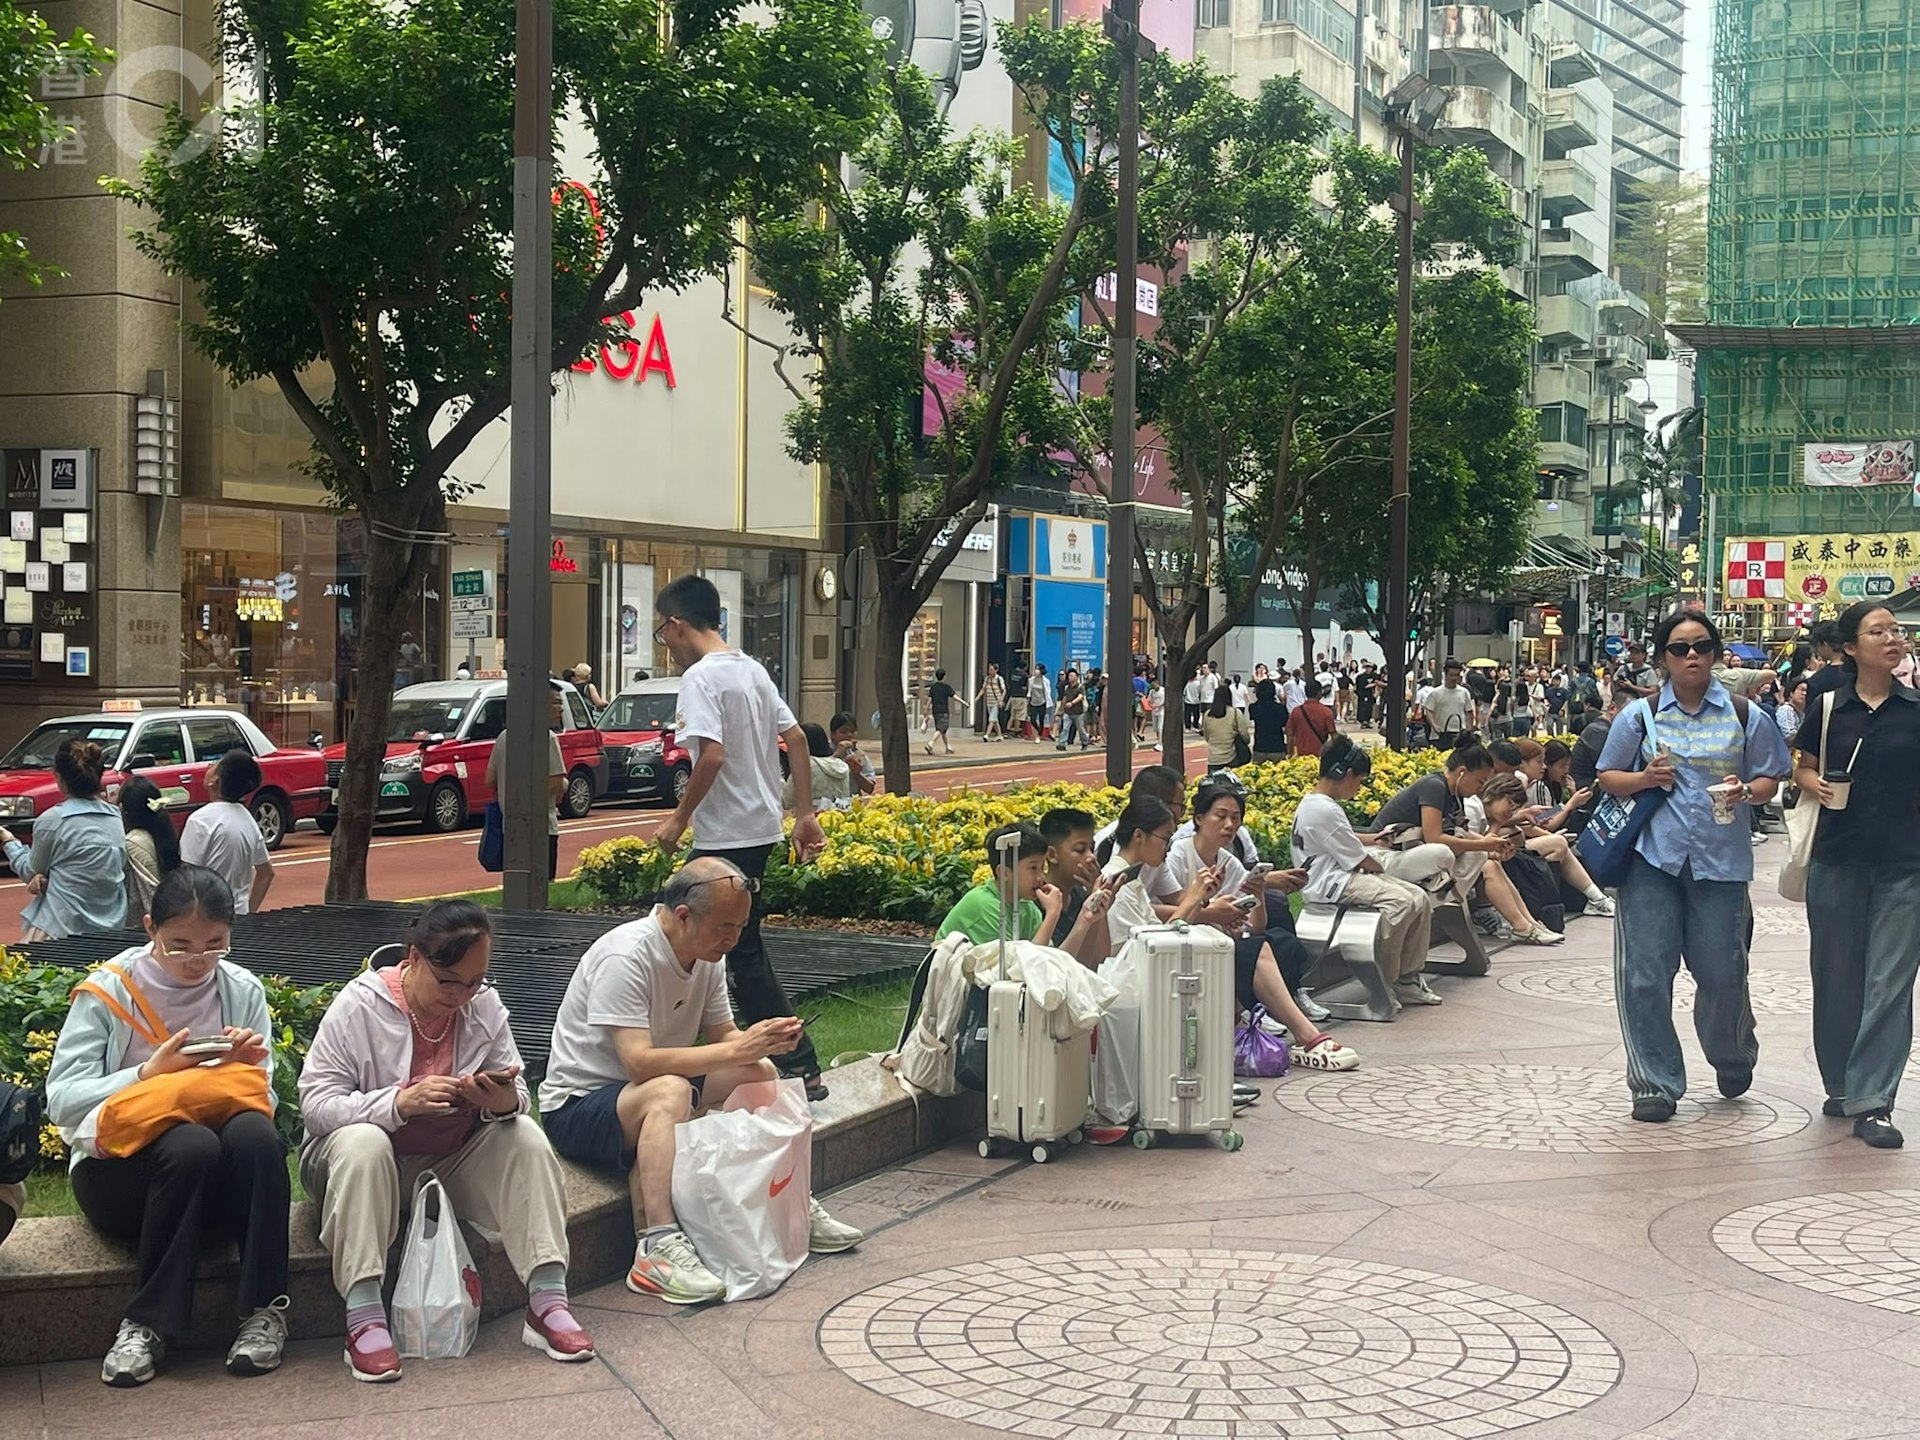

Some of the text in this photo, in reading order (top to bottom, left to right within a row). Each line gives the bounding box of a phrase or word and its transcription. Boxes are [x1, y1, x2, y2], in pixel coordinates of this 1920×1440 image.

[1791, 538, 1920, 562] 盛泰中西藥
[1791, 563, 1820, 571] SHING
[1841, 561, 1890, 569] PHARMACY
[104, 701, 134, 710] TAXI
